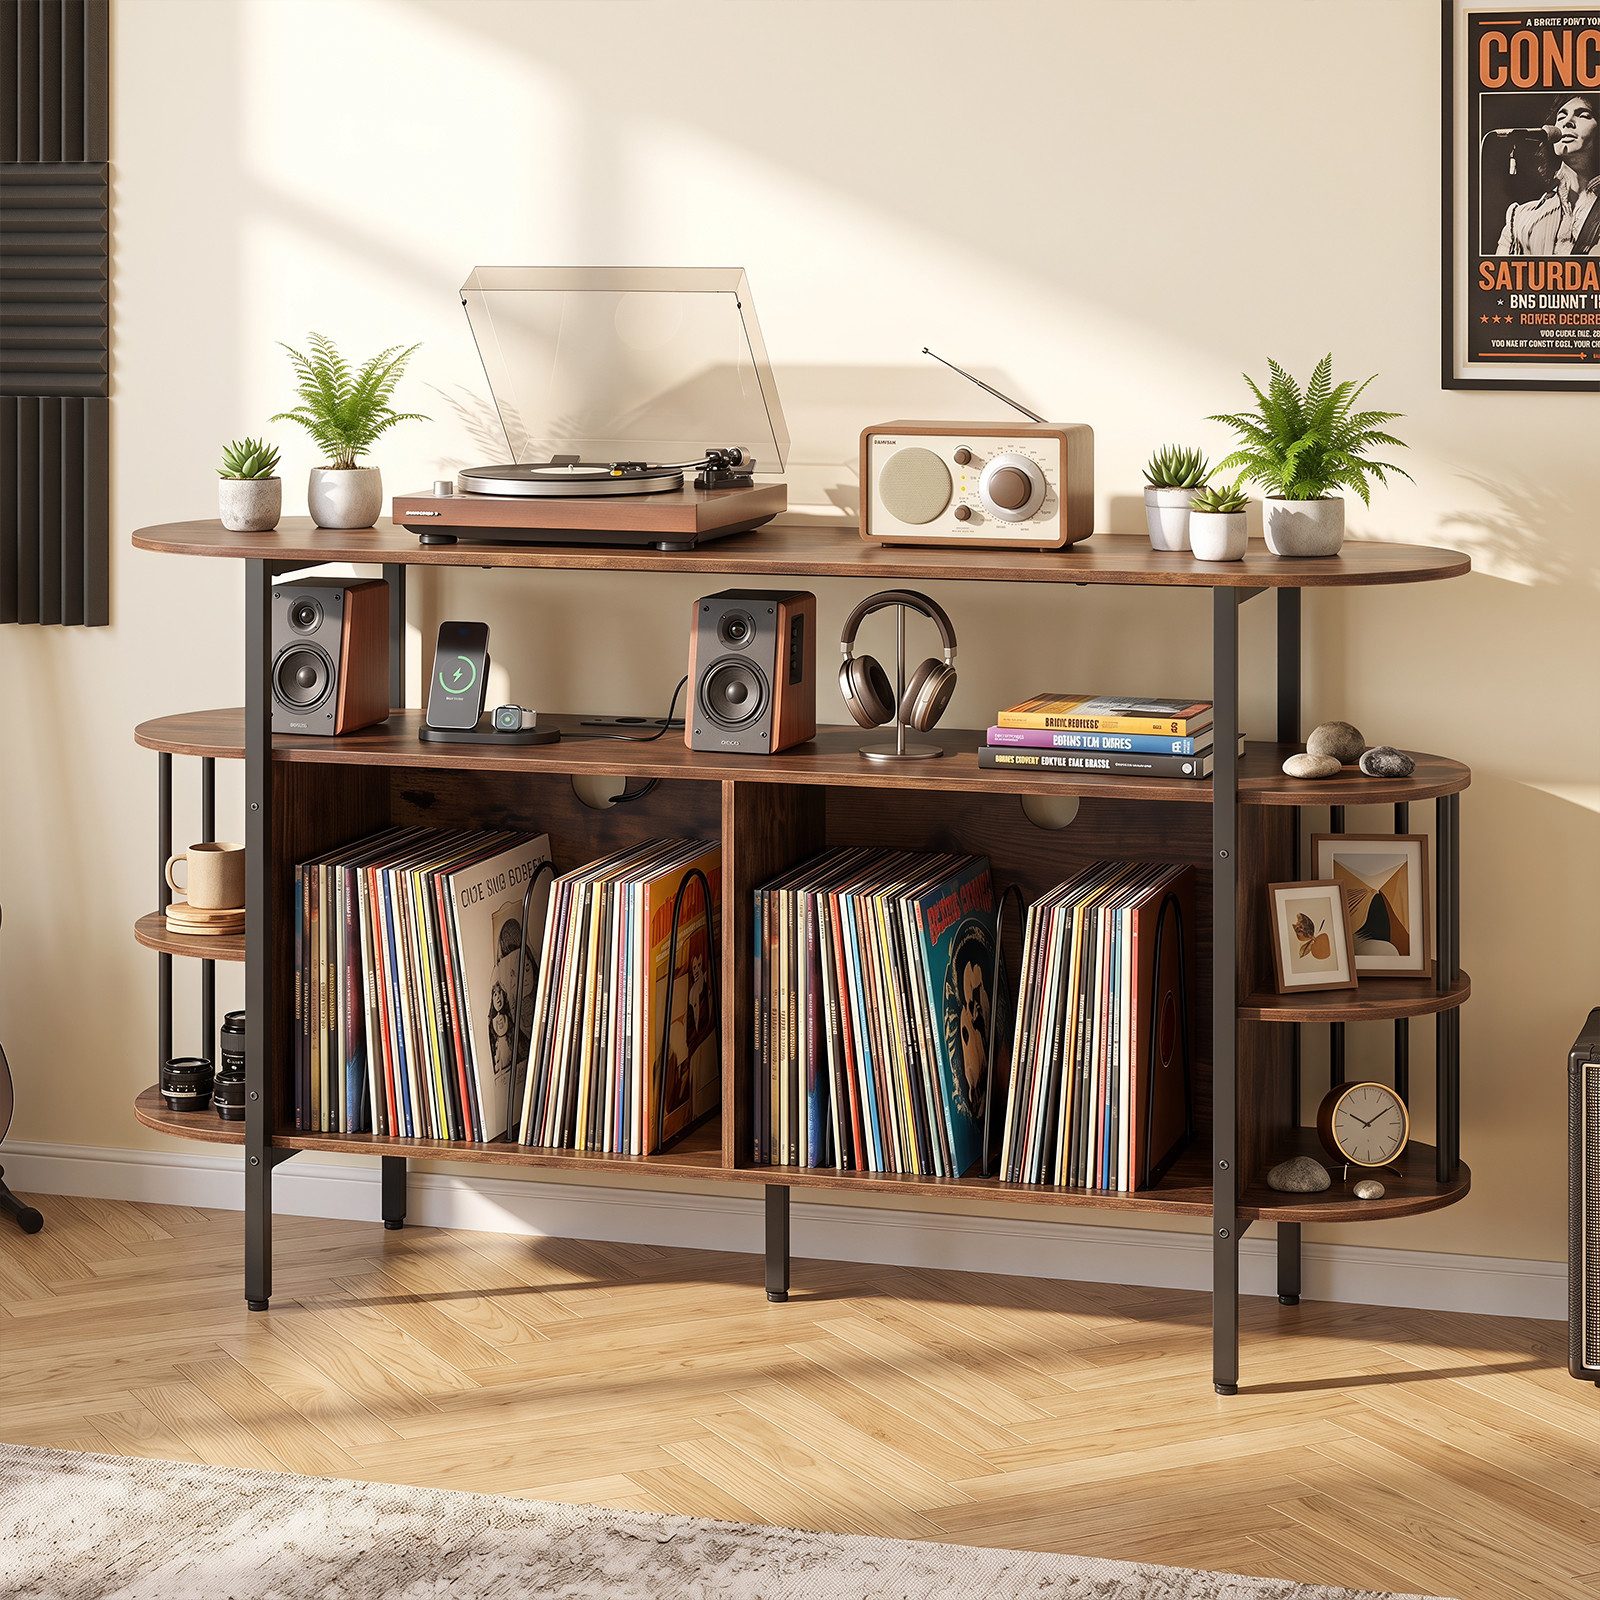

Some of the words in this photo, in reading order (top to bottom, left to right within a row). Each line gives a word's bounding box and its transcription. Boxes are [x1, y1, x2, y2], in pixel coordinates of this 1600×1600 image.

[1526, 18, 1533, 27] A
[1480, 30, 1600, 88] CONC
[1479, 260, 1600, 291] SATURDA
[1510, 294, 1536, 309] BNS
